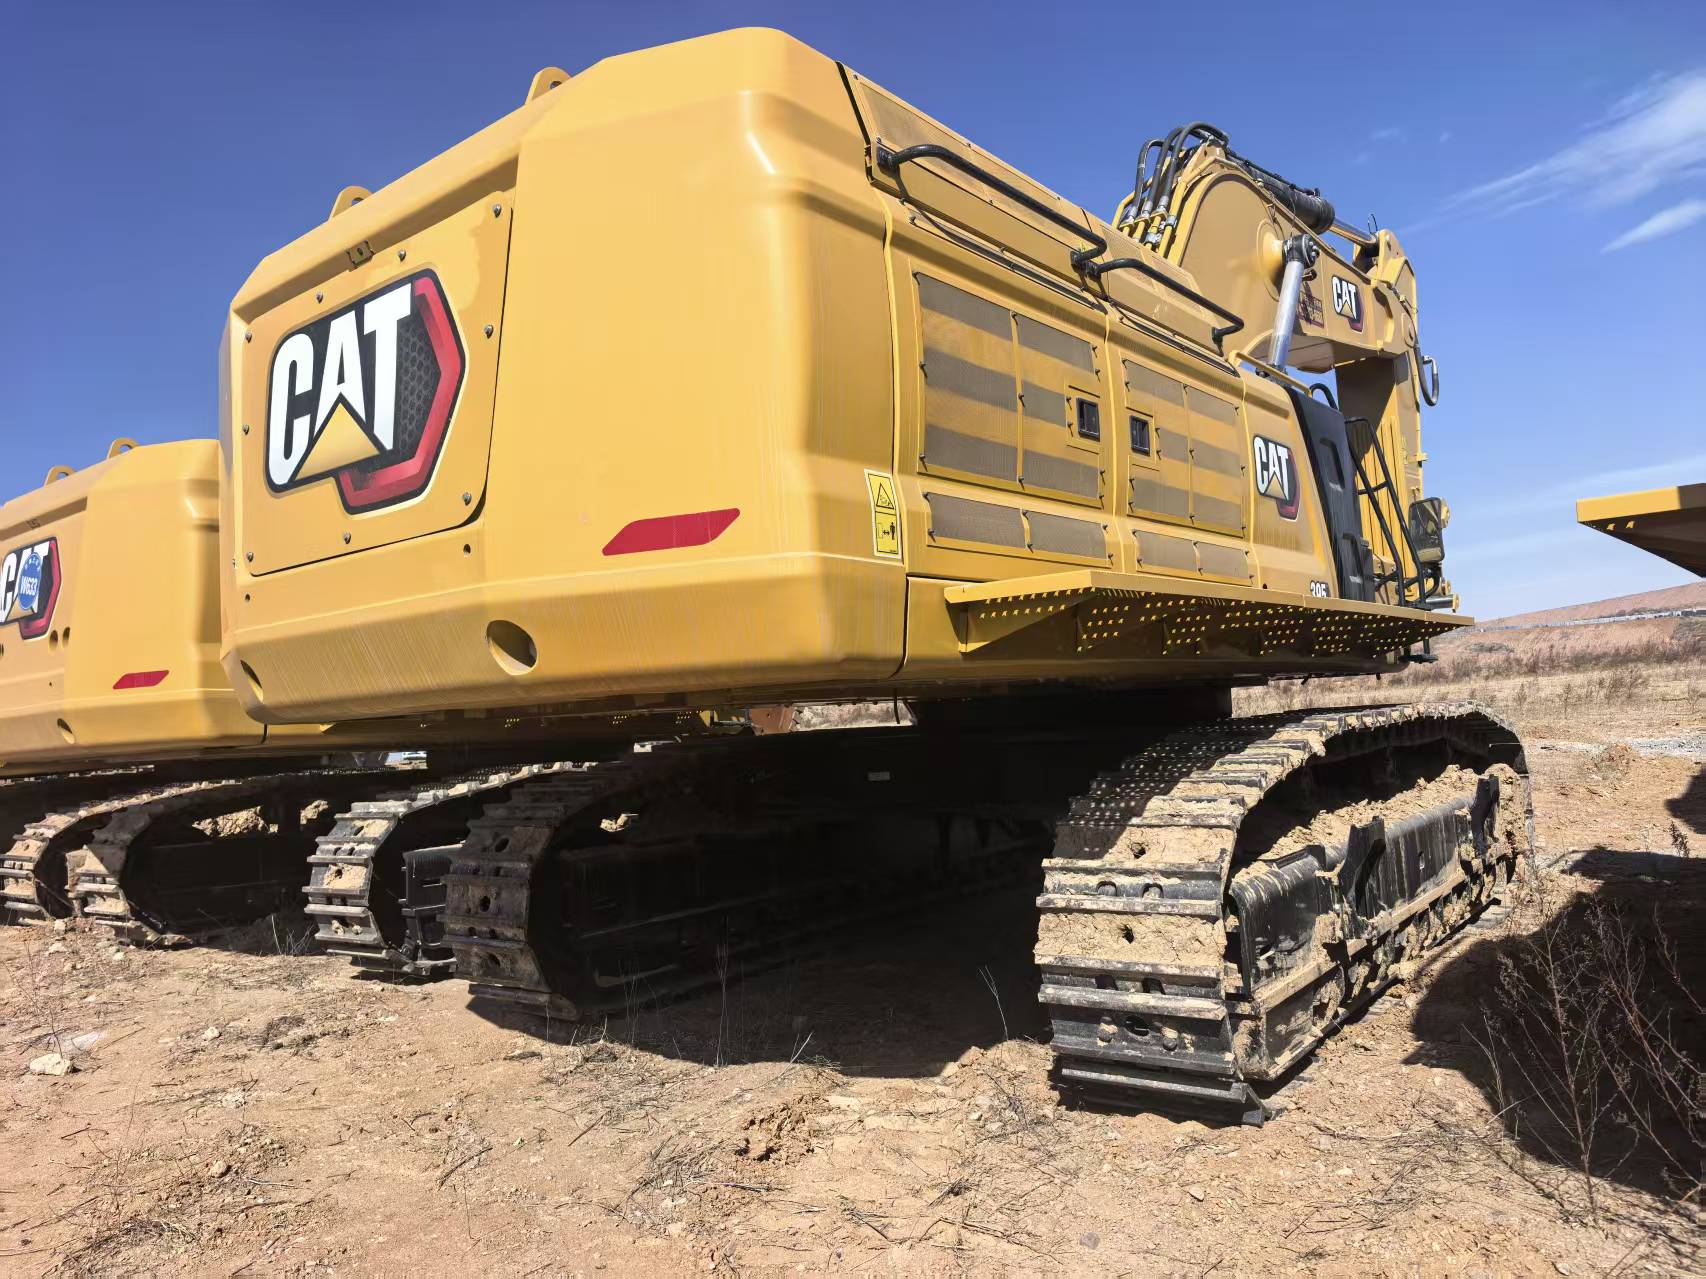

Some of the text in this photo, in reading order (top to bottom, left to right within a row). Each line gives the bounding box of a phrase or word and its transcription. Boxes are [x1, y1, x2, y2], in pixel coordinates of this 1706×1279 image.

[1332, 276, 1357, 319] CAT
[268, 282, 412, 485] CAT
[1253, 436, 1289, 500] CAT
